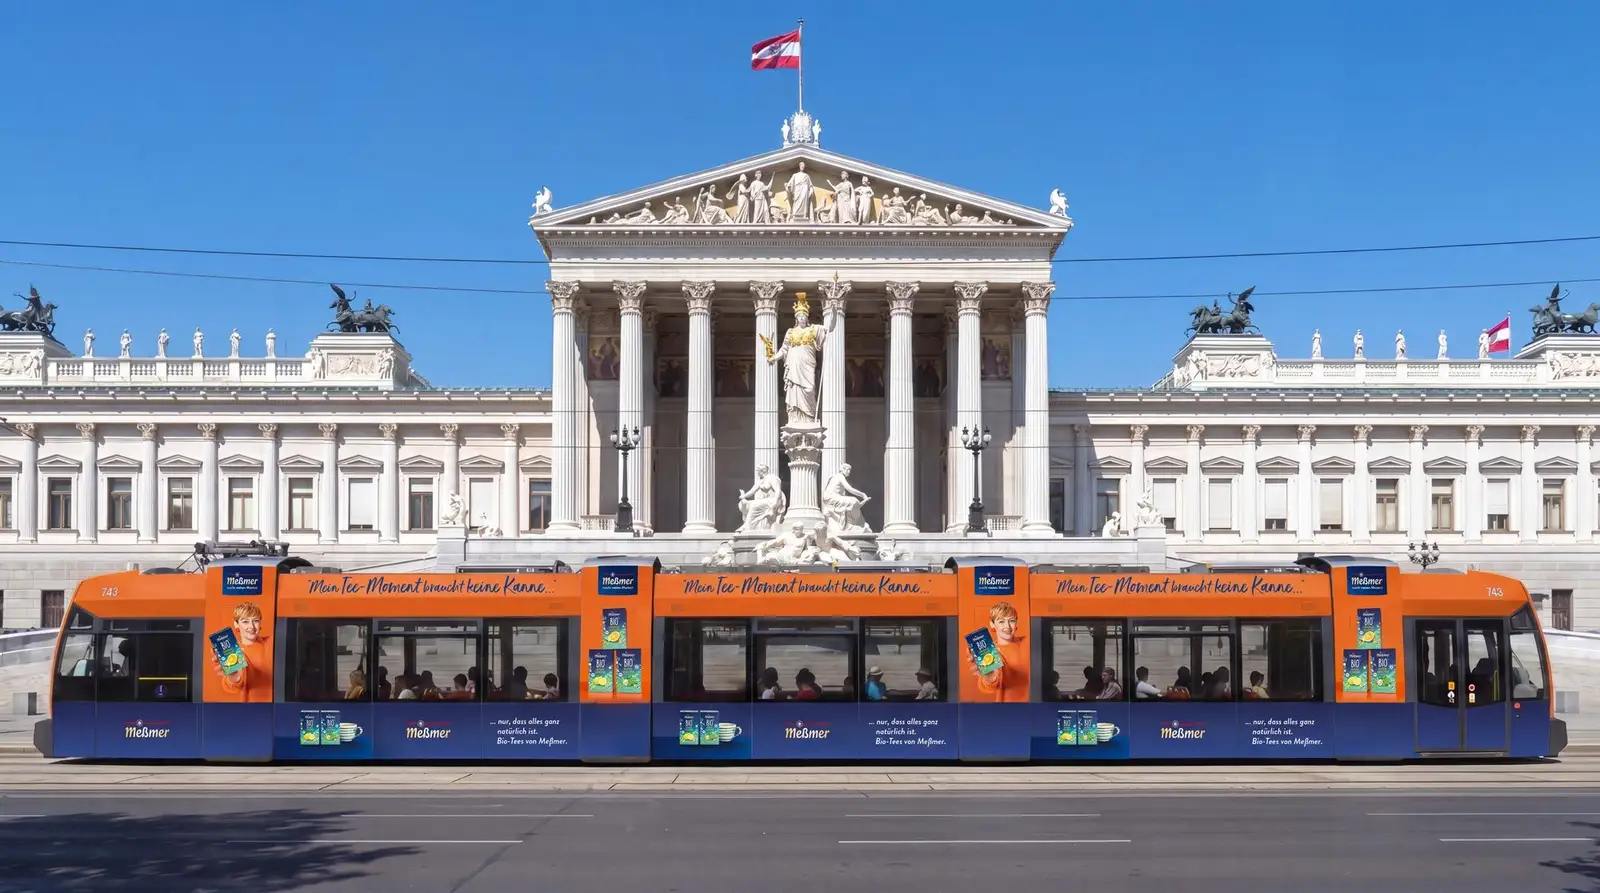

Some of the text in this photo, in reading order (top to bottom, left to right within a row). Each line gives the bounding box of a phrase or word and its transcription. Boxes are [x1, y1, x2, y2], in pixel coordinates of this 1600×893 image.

[226, 577, 258, 585] Meßmer
[341, 576, 422, 594] Tee-Moment
[423, 580, 464, 593] braucht
[466, 578, 500, 593] keine
[602, 577, 634, 585] Meßmer
[716, 576, 799, 594] Tee-Moment
[799, 580, 840, 593] braucht
[842, 578, 875, 593] keine
[978, 577, 1010, 585] Meßmer
[1089, 576, 1170, 594] Tee-Moment
[1172, 580, 1214, 593] braucht
[1214, 578, 1248, 593] keine
[1351, 577, 1383, 585] Meßmer
[102, 588, 118, 596] 743
[1486, 588, 1504, 596] 743
[125, 726, 170, 738] Meßmer
[406, 727, 451, 738] Meßmer
[785, 728, 830, 738] Meßmer
[1161, 728, 1205, 738] Meßmer
[538, 737, 568, 747] Meßmer.
[917, 737, 946, 747] Meßmer.
[1294, 737, 1323, 747] Meßmer.
